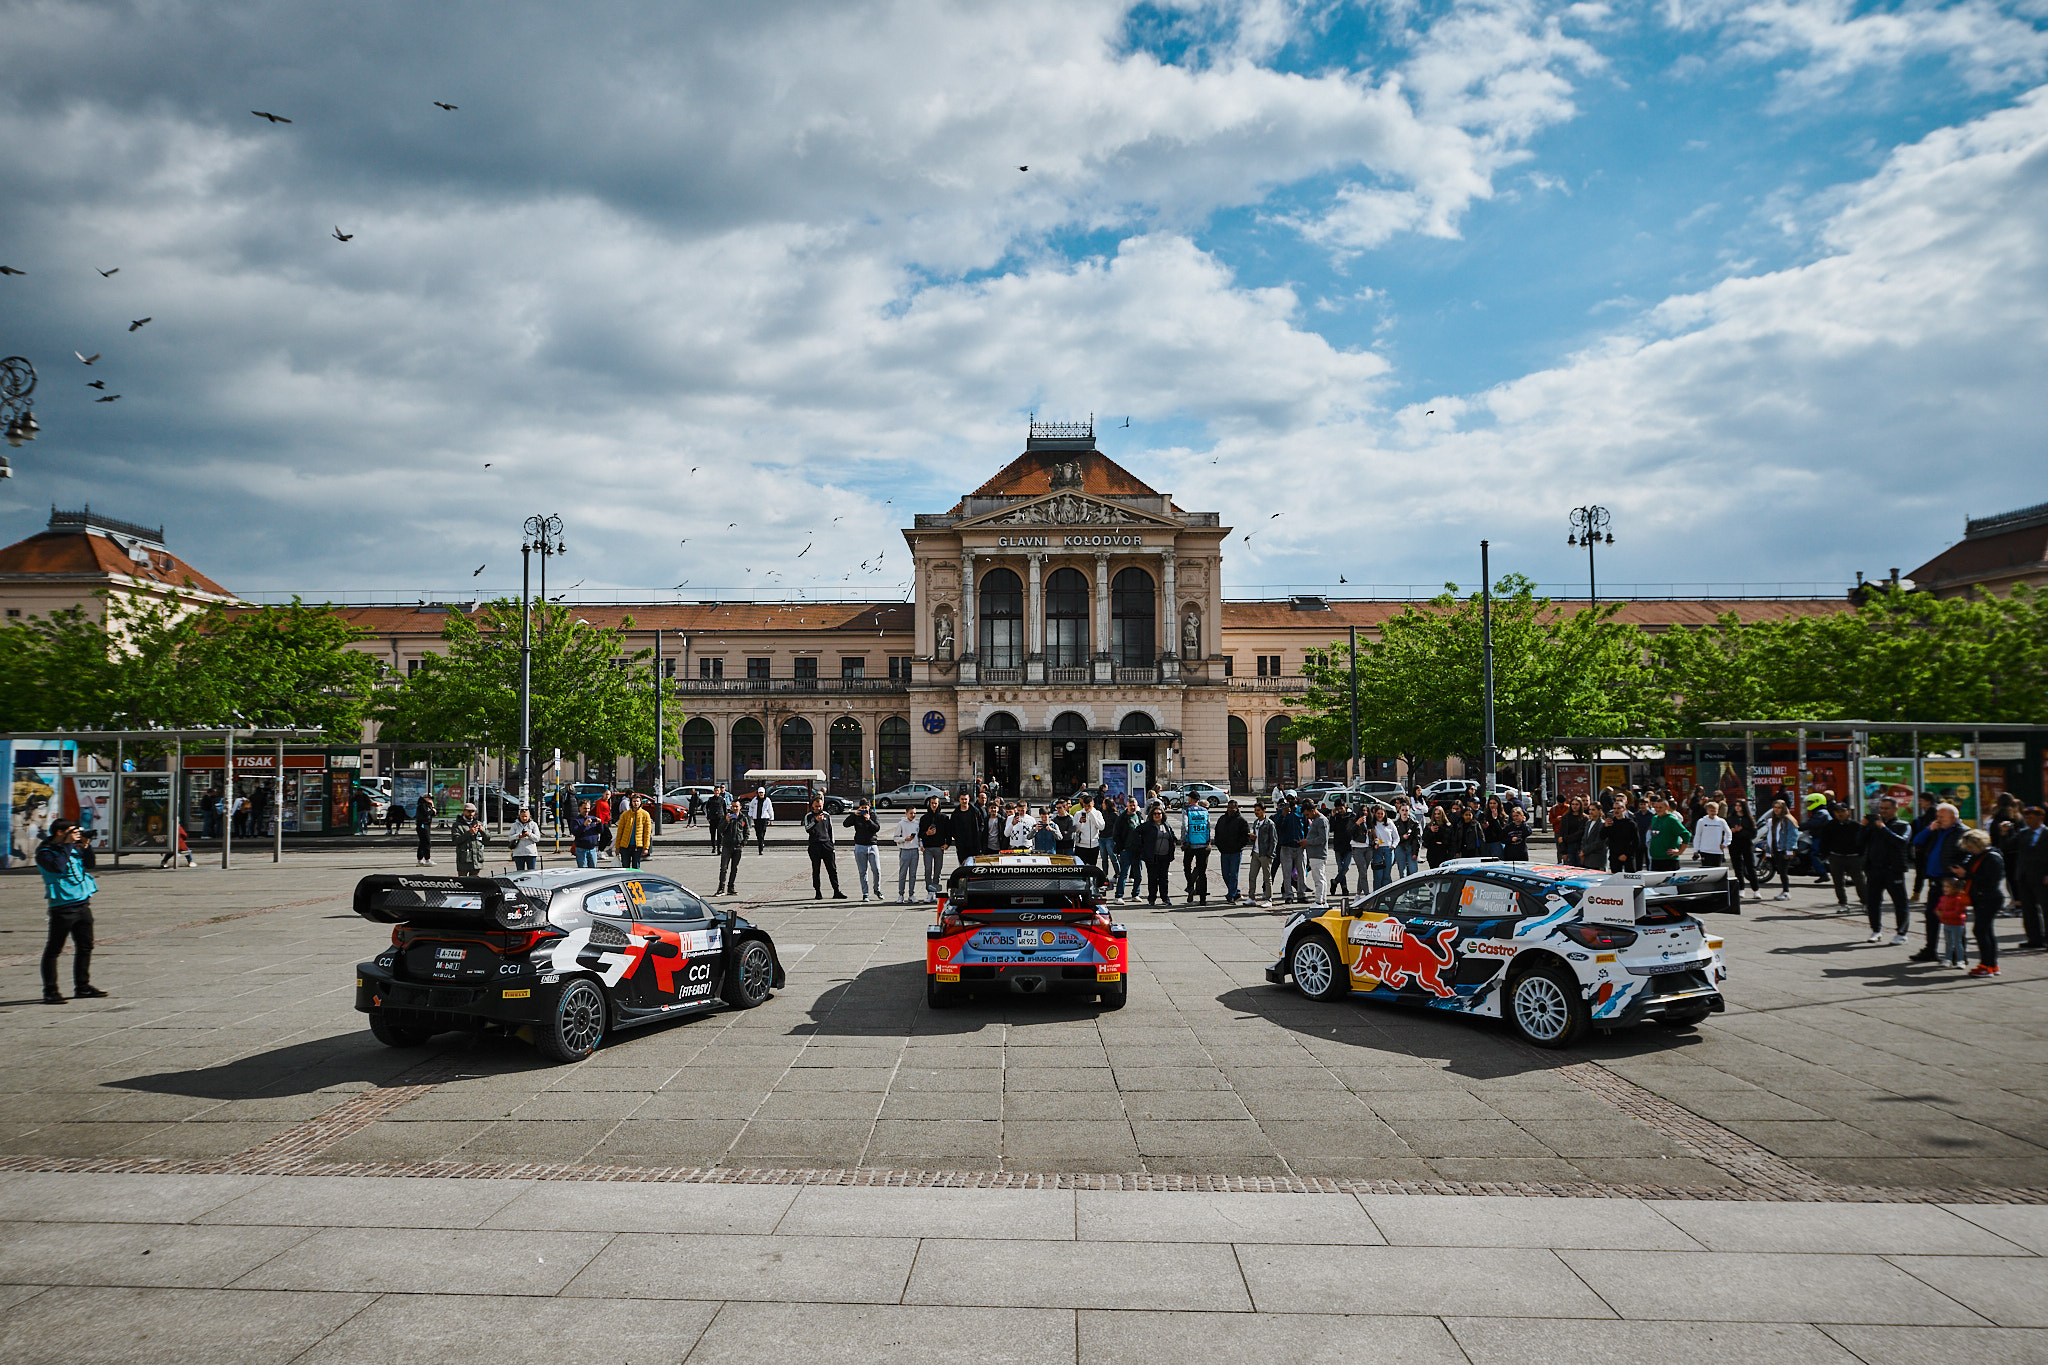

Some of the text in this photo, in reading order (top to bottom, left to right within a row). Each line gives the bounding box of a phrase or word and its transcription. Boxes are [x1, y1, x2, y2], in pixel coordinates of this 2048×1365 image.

[998, 535, 1142, 547] GLAVNI KOLODVOR
[236, 757, 273, 767] TISAK
[1753, 766, 1787, 775] SKINI ME!
[79, 779, 109, 788] WOW
[1754, 777, 1782, 785] COCA-COLA
[398, 877, 464, 890] Panasonic
[627, 881, 647, 905] 33
[1461, 886, 1475, 906] 16
[1595, 897, 1623, 906] Castrol
[1603, 916, 1634, 924] SafetyCulture
[983, 936, 1015, 945] MOBIS
[1478, 943, 1518, 957] Castrol
[1569, 952, 1587, 960] Ford
[504, 990, 529, 998] PIRELLI
